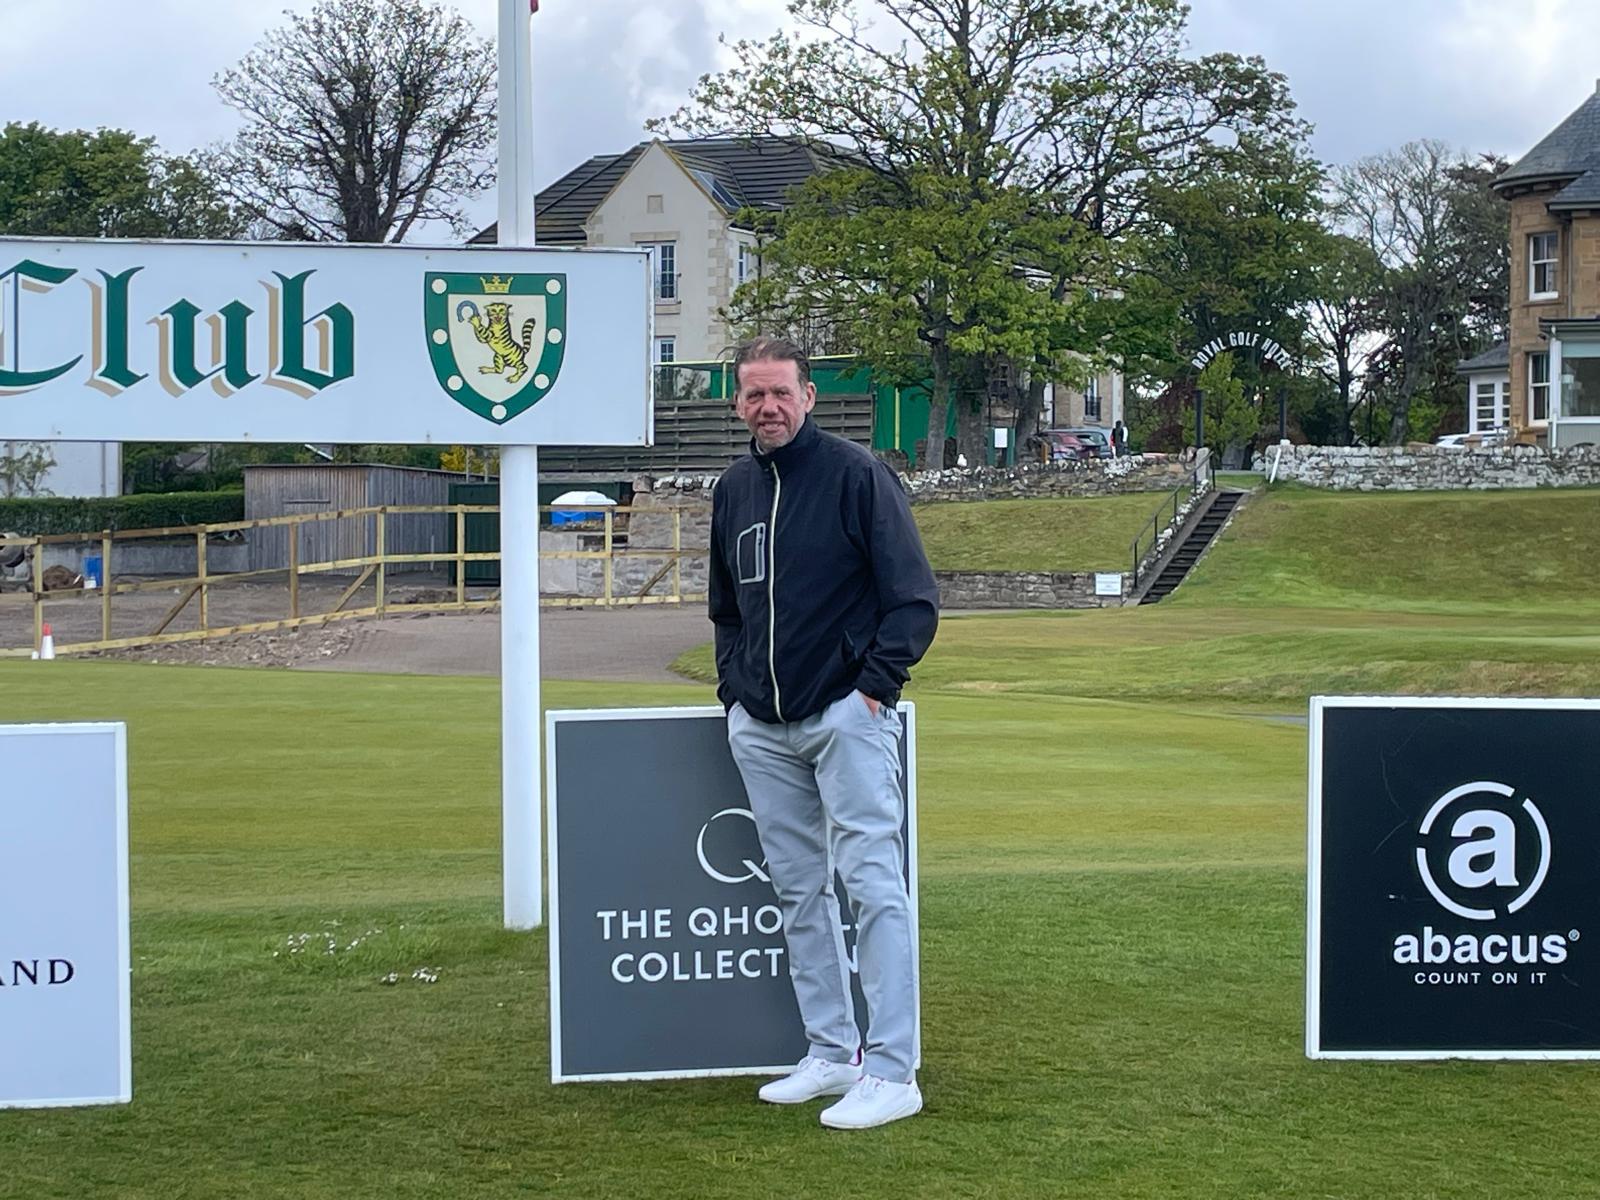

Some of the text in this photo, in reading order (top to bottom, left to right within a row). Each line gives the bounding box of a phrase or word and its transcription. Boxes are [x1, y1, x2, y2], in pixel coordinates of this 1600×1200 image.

[0, 259, 356, 395] Club
[1191, 331, 1292, 371] ROYAL GOLF HOTEL
[597, 909, 672, 940] THE
[0, 959, 74, 986] ND
[1414, 972, 1547, 985] COUNT ON IT
